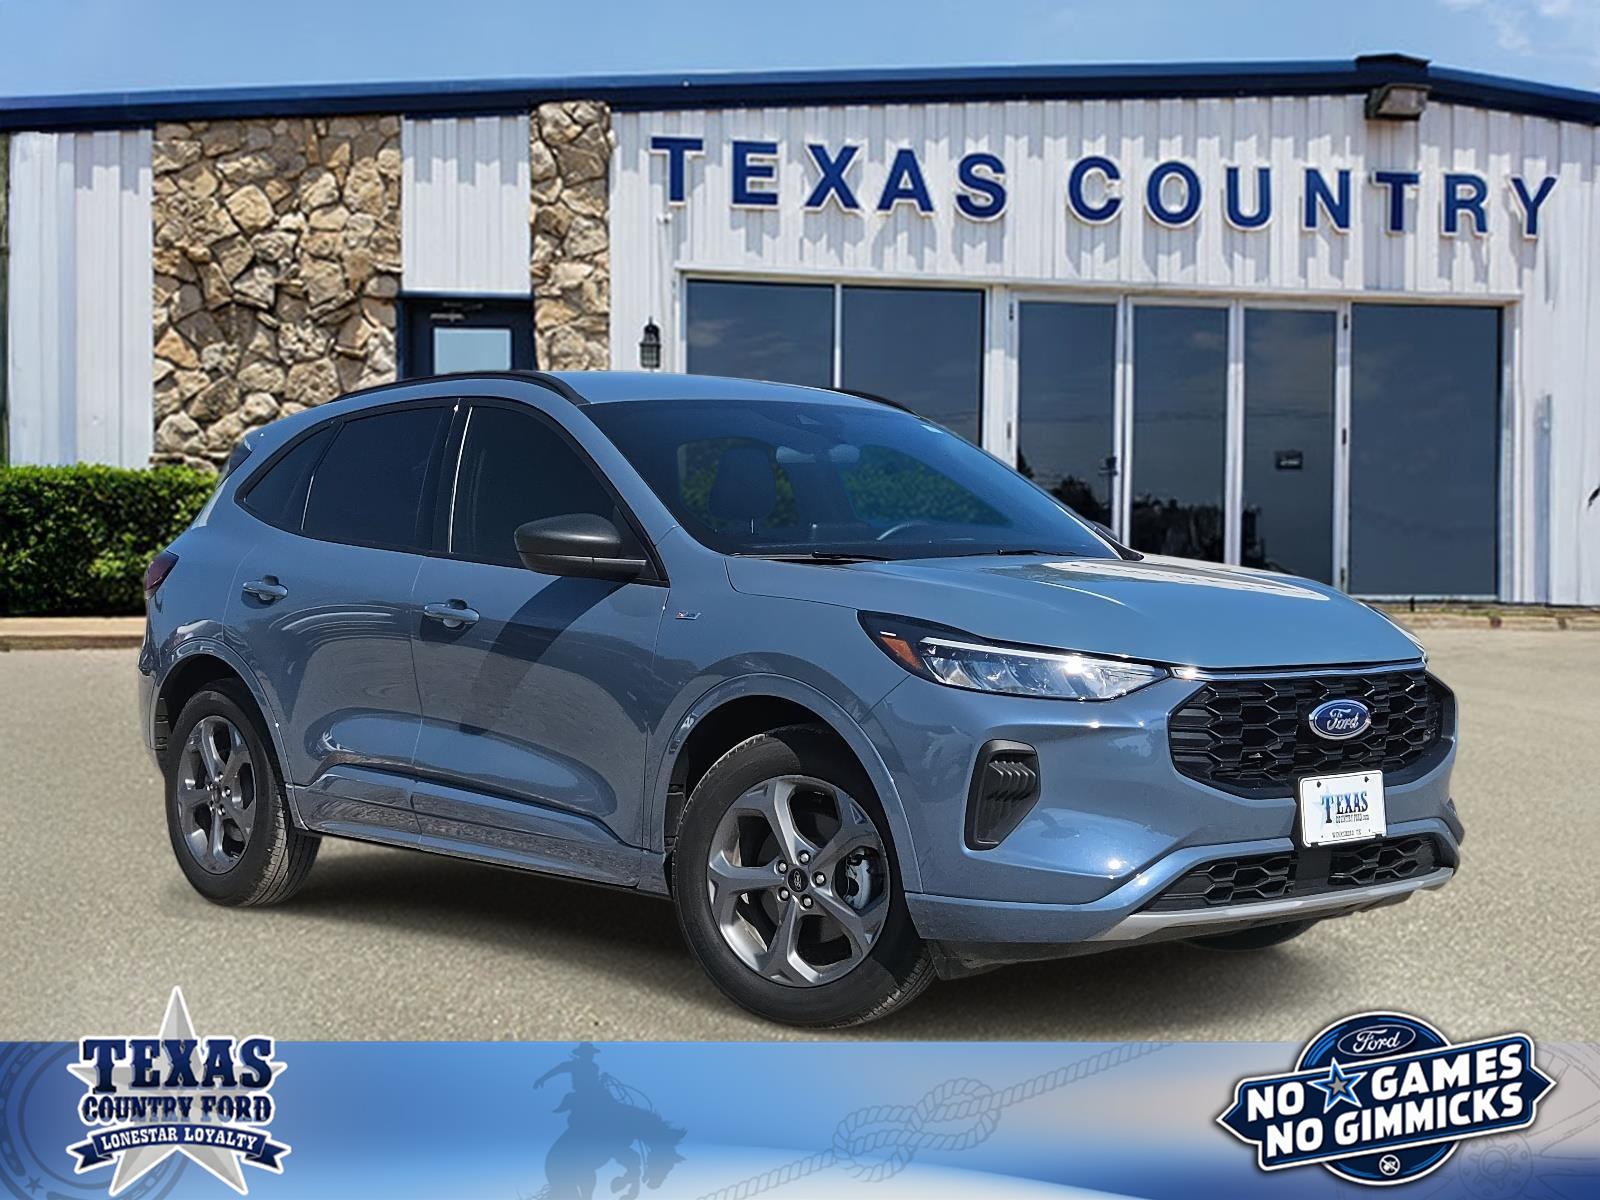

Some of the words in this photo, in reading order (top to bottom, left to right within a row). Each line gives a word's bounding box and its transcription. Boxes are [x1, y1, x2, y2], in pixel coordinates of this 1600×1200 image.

[650, 136, 1007, 219] TEXAS
[1067, 155, 1559, 237] COUNTRY
[1326, 708, 1360, 731] Ford
[1321, 791, 1369, 824] TEXAS
